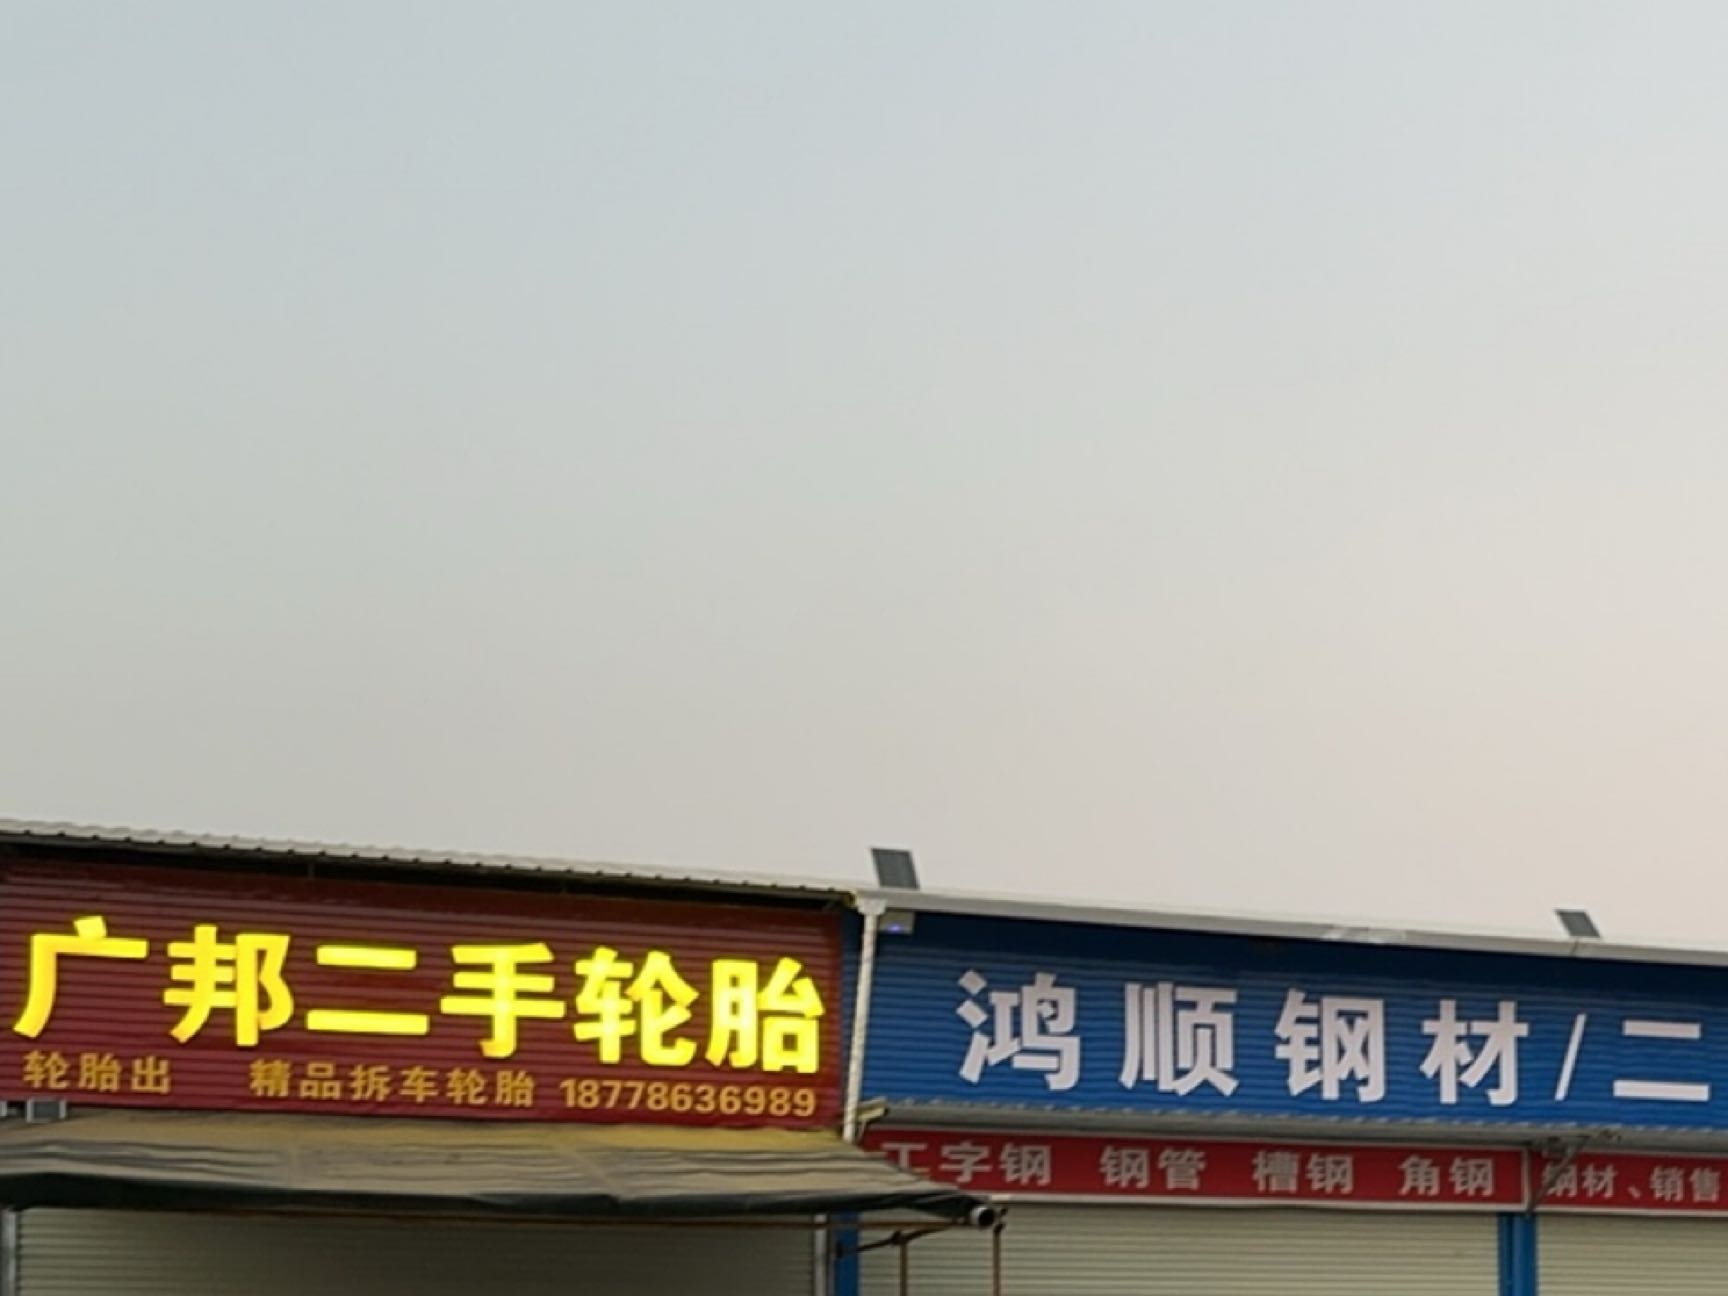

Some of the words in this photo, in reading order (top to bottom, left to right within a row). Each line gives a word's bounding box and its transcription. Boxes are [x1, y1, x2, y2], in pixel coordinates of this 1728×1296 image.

[14, 915, 826, 1074] 广邦二手轮胎
[22, 1049, 172, 1095] 轮胎出
[248, 1057, 536, 1108] 精品拆车轮胎
[560, 1077, 817, 1117] 18778636989
[878, 1141, 1052, 1187] 工字钢
[1099, 1145, 1205, 1191] 钢管
[1252, 1150, 1353, 1193] 槽钢
[1397, 1153, 1495, 1196] 角钢
